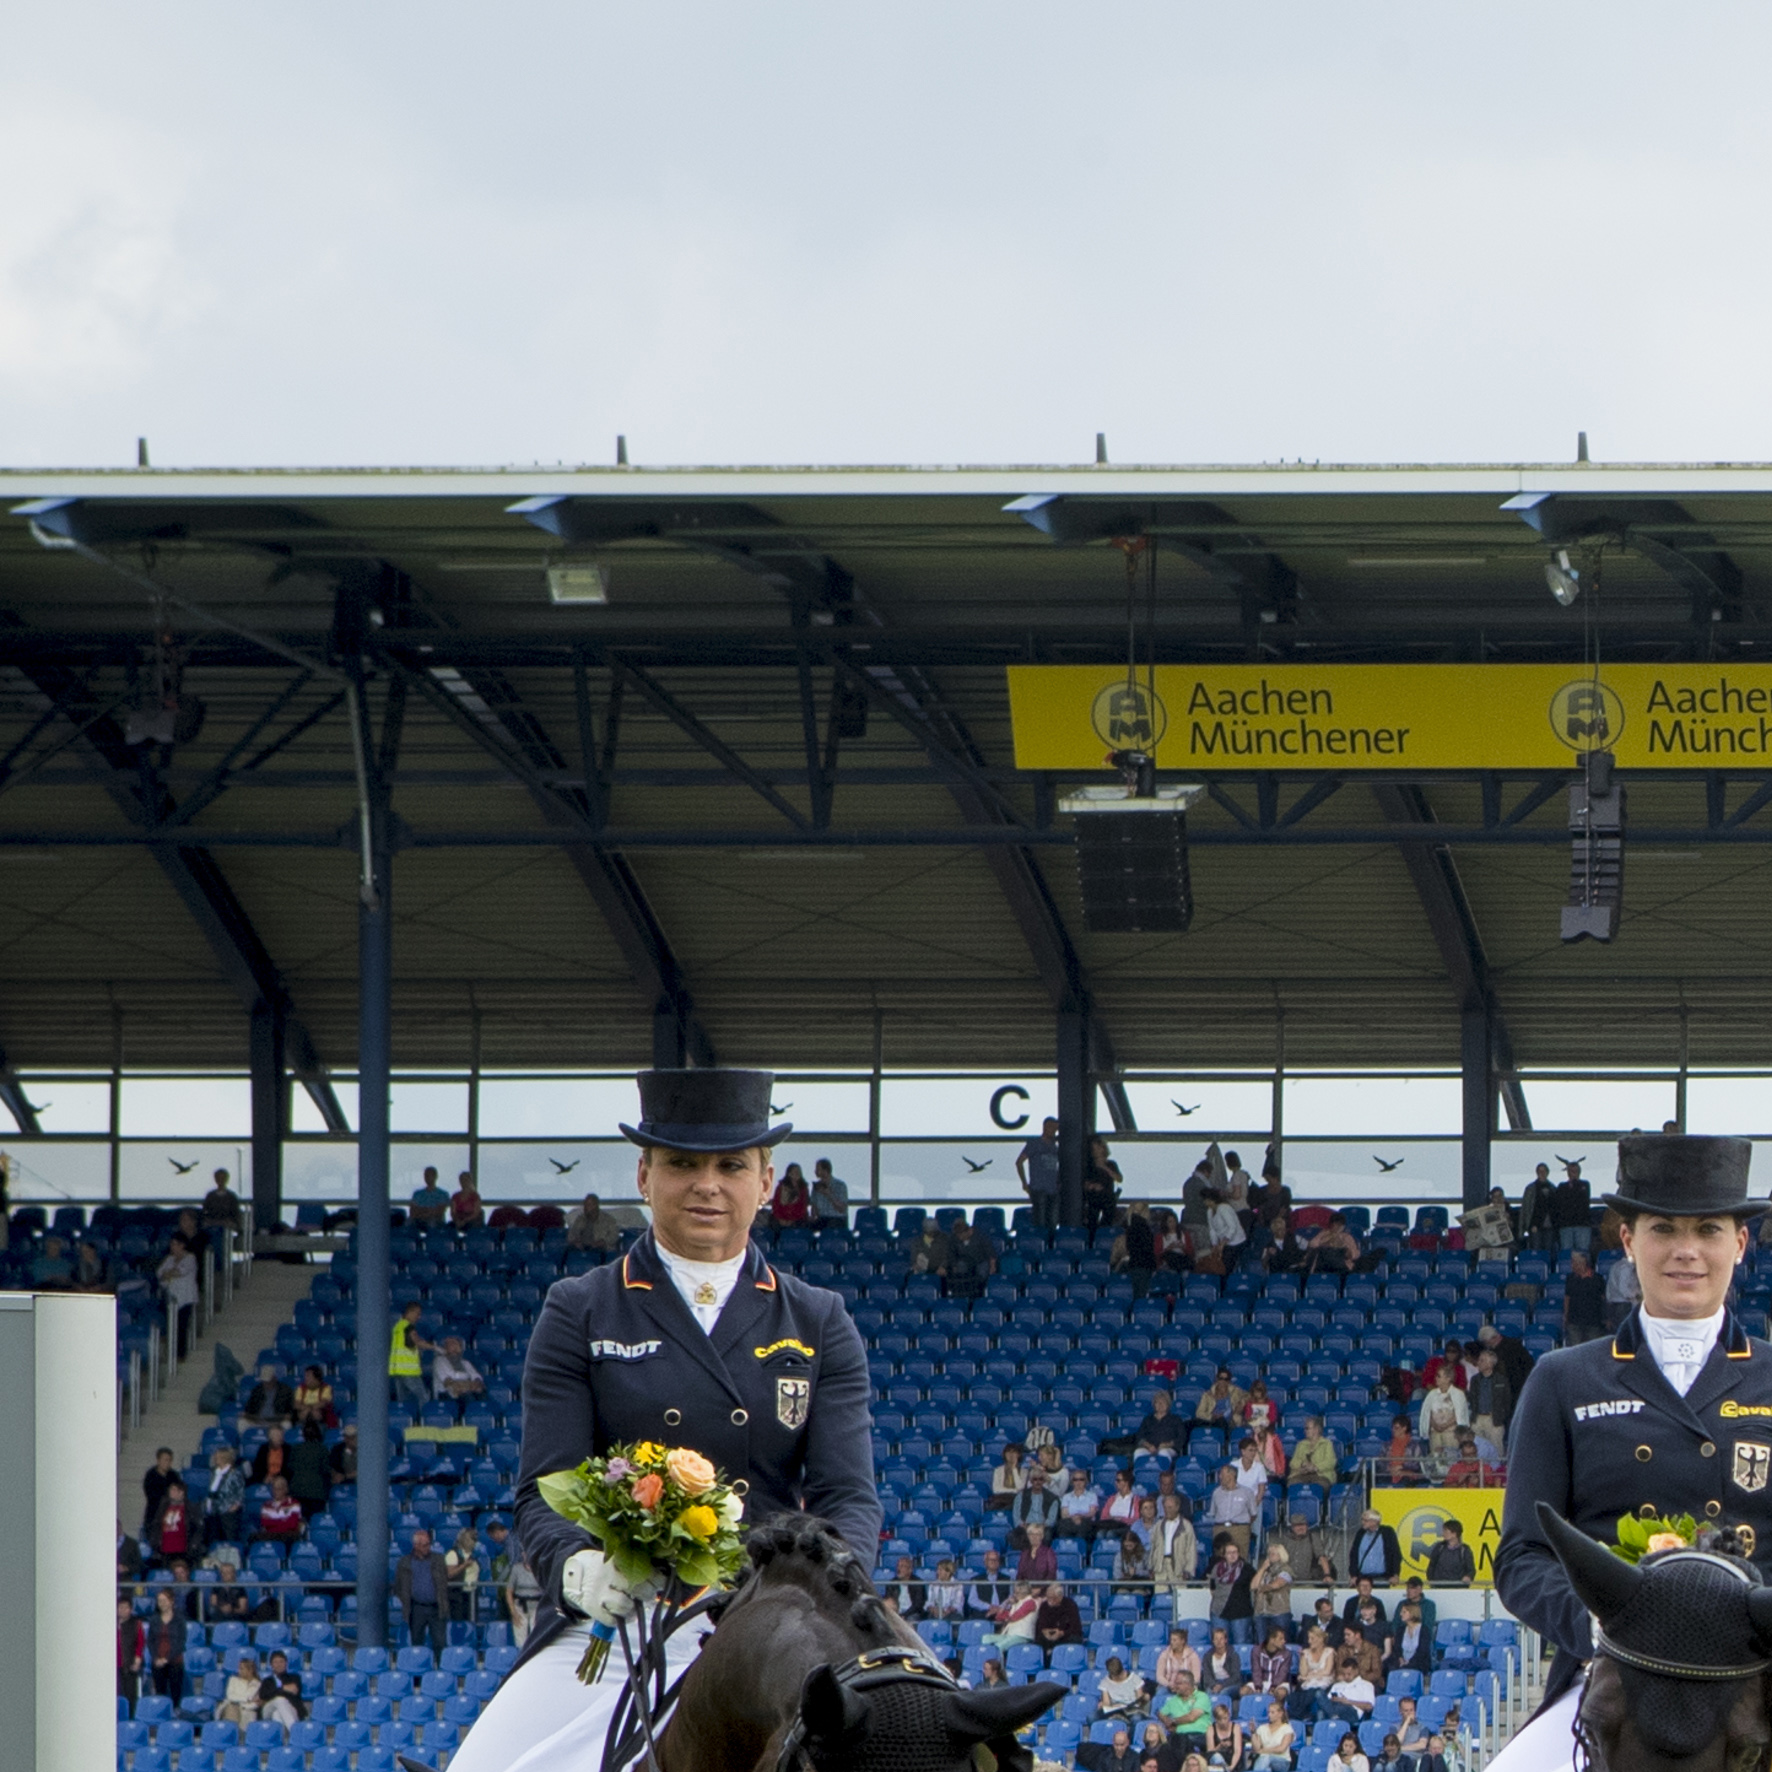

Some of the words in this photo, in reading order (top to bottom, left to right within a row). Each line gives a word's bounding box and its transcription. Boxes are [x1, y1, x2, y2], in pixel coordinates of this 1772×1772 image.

[1187, 679, 1334, 715] Aachen
[1190, 719, 1410, 755] Münchener
[989, 1084, 1030, 1130] C
[590, 1340, 662, 1358] FENDT
[1574, 1400, 1645, 1421] FENDT
